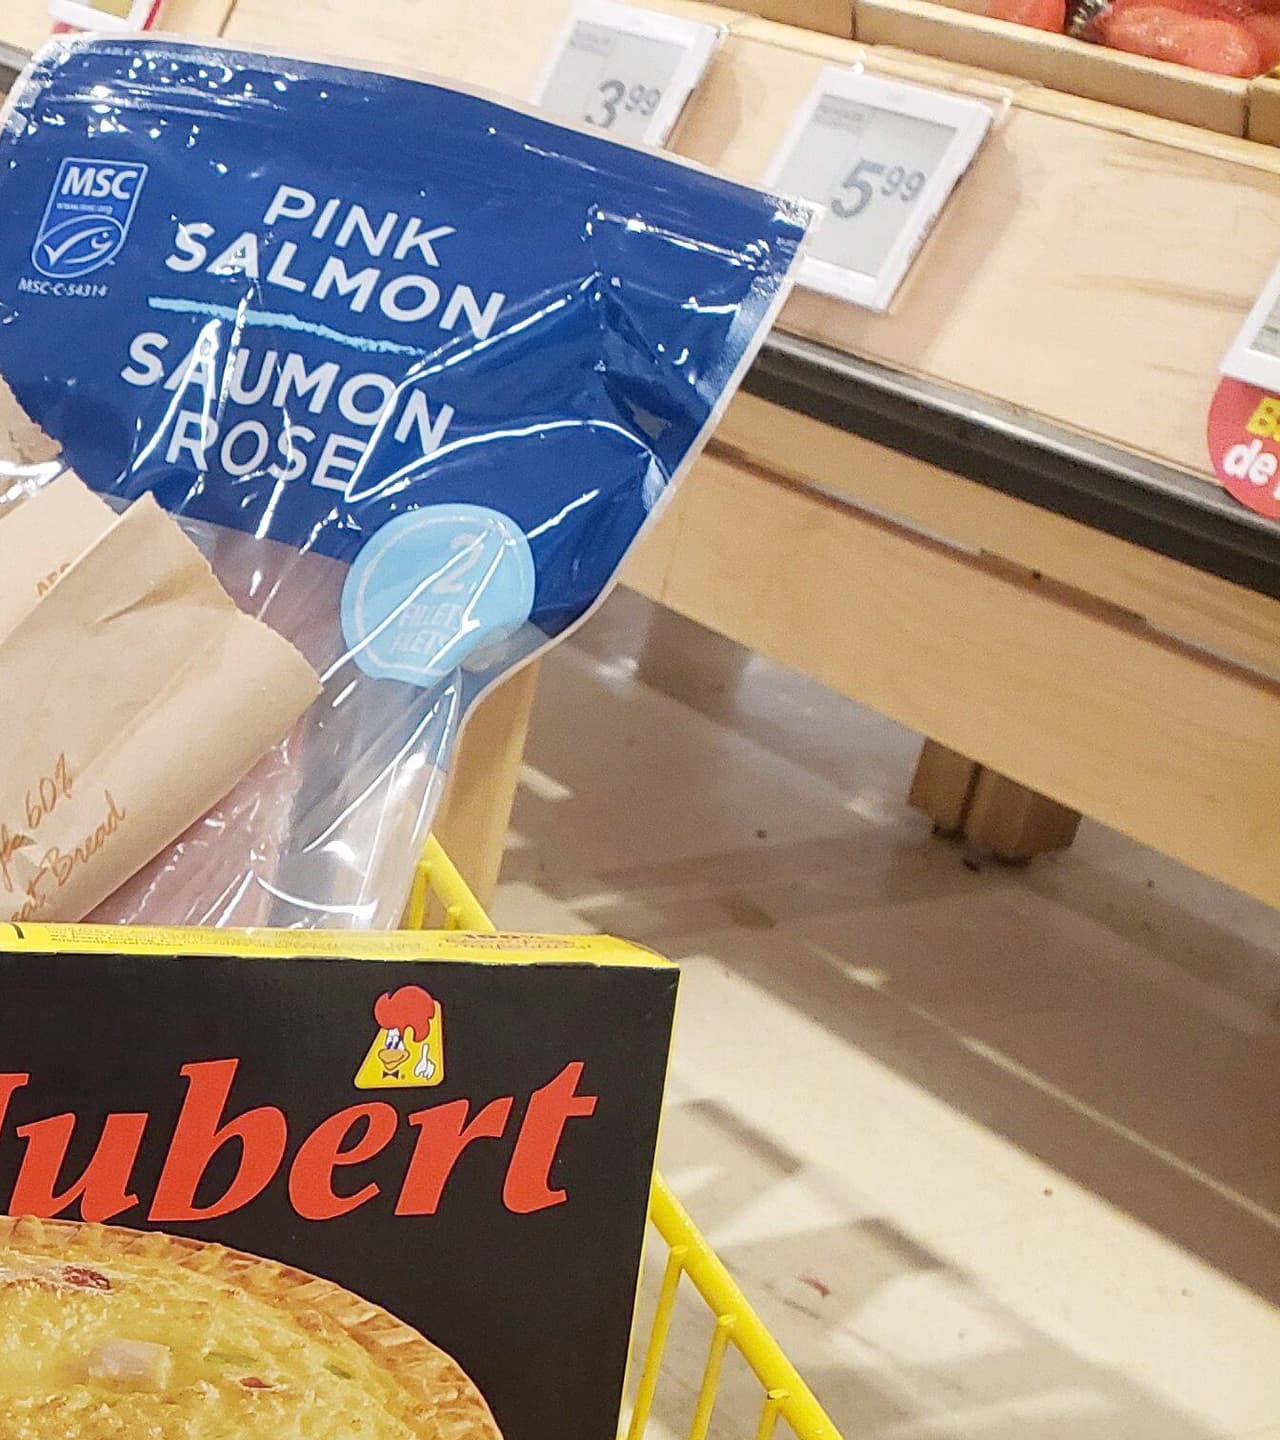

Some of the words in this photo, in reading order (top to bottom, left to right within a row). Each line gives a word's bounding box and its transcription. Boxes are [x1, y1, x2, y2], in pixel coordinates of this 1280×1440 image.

[61, 166, 139, 200] MSC
[262, 184, 456, 270] PINK
[165, 221, 507, 340] SALMON
[121, 332, 455, 456] SAUMON
[1222, 438, 1279, 487] de
[40, 788, 126, 887] Bread
